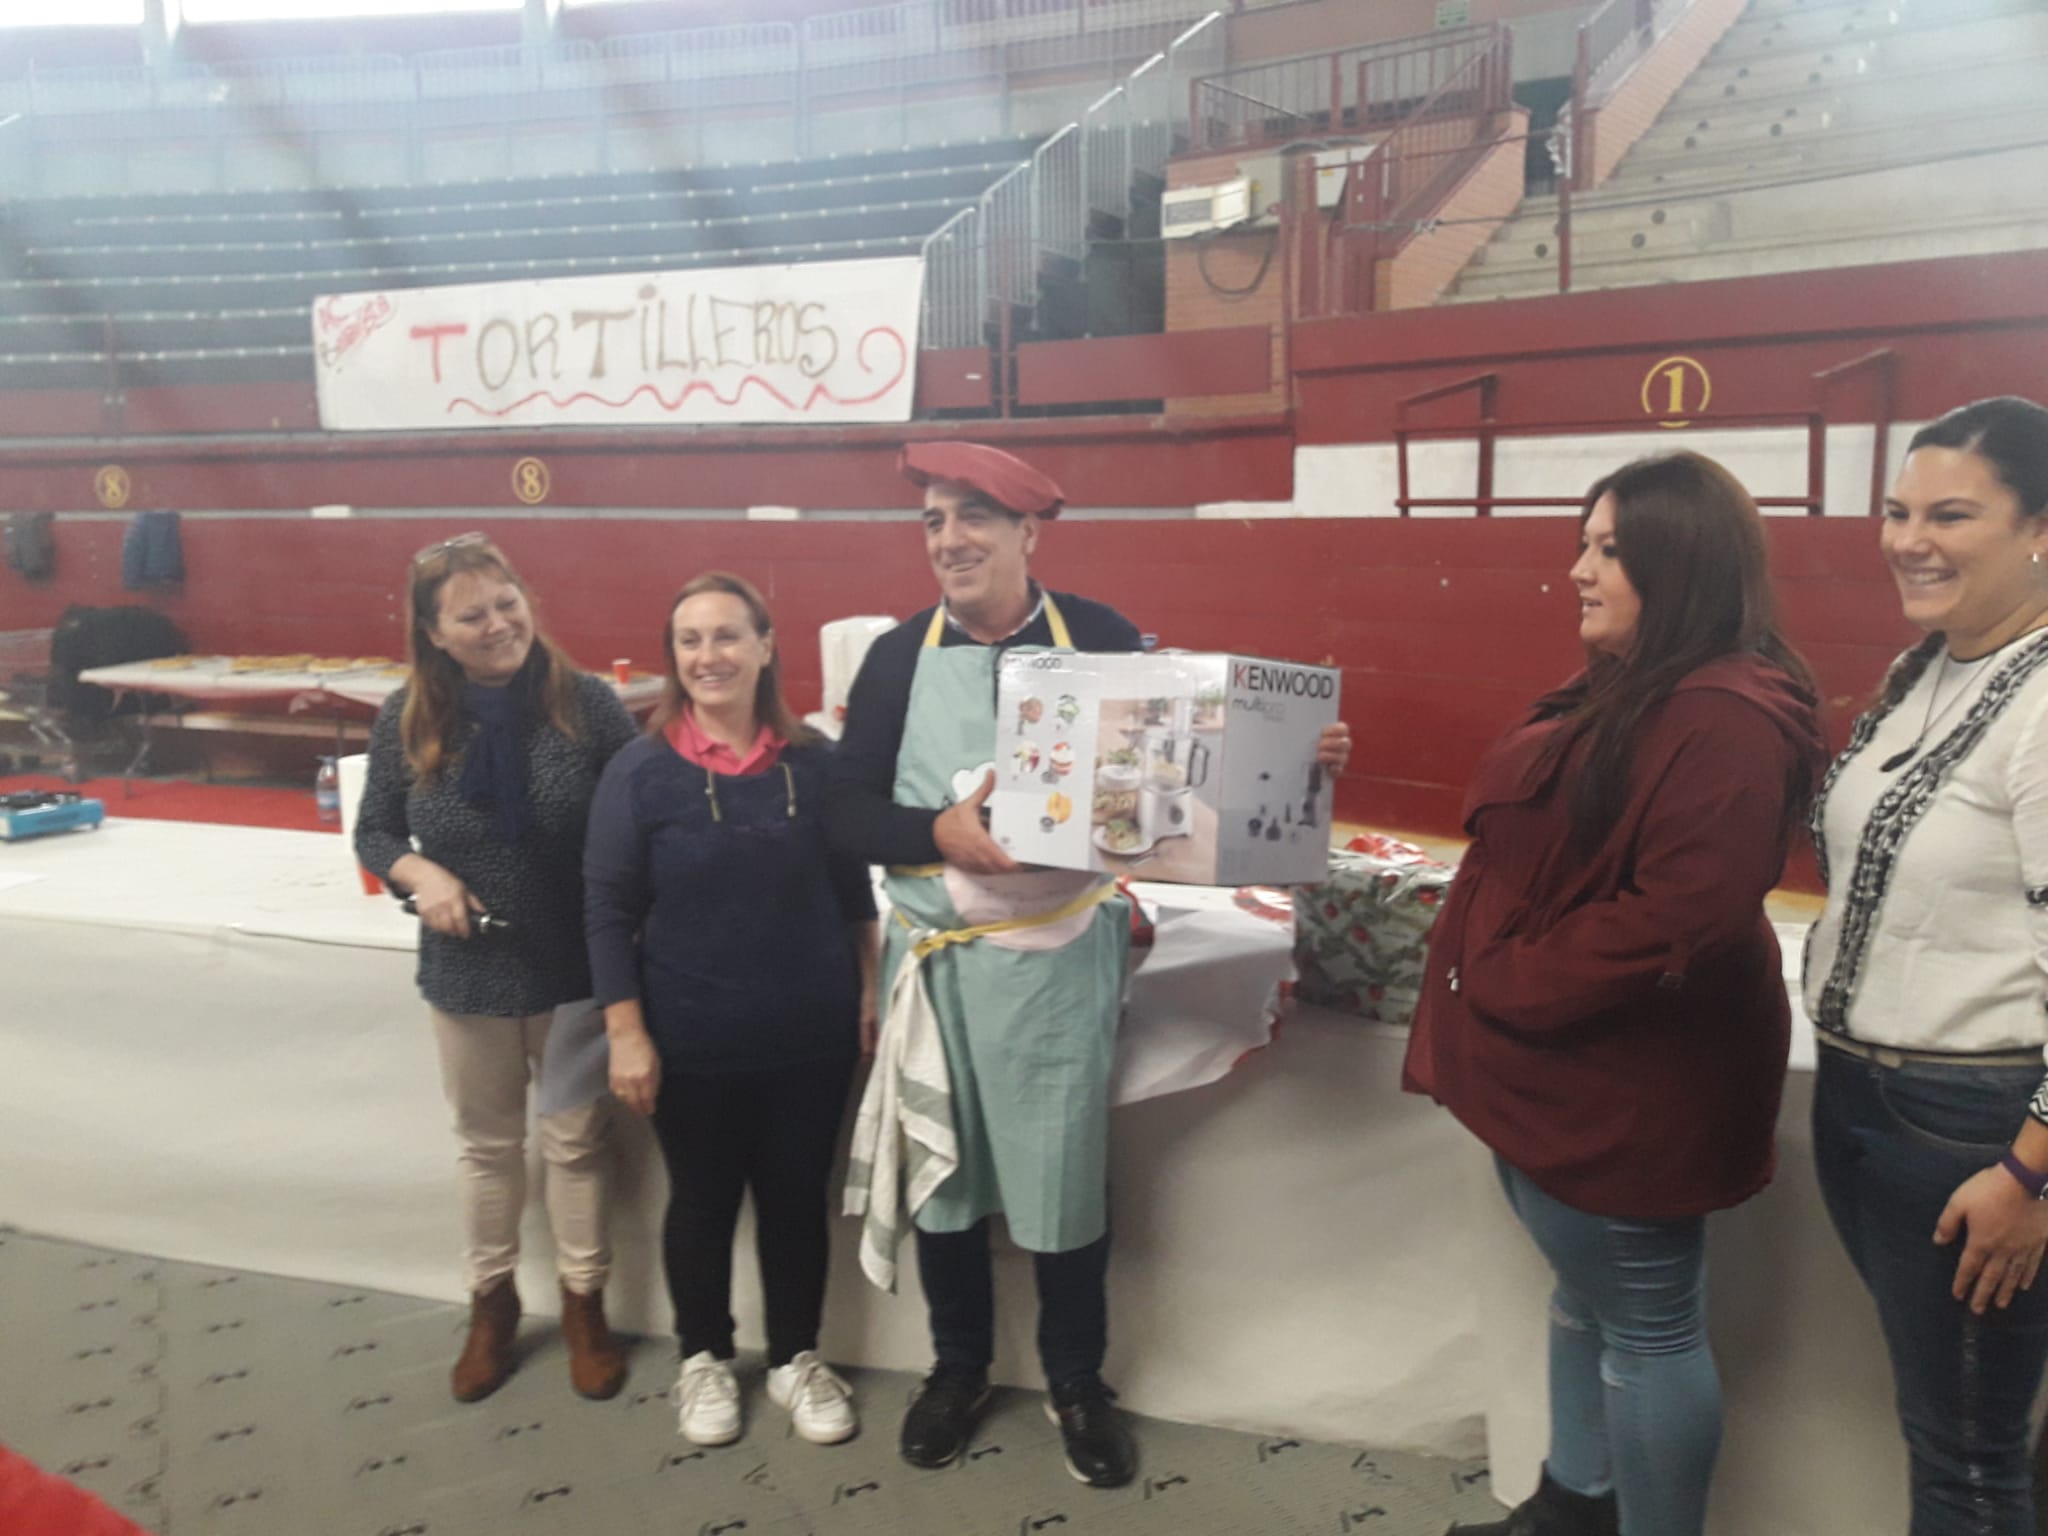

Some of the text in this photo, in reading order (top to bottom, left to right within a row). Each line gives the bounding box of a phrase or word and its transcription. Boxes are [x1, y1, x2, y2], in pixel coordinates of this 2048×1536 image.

[1663, 365, 1684, 413] 1
[522, 464, 540, 498] 8
[1233, 663, 1334, 699] KENWOOD
